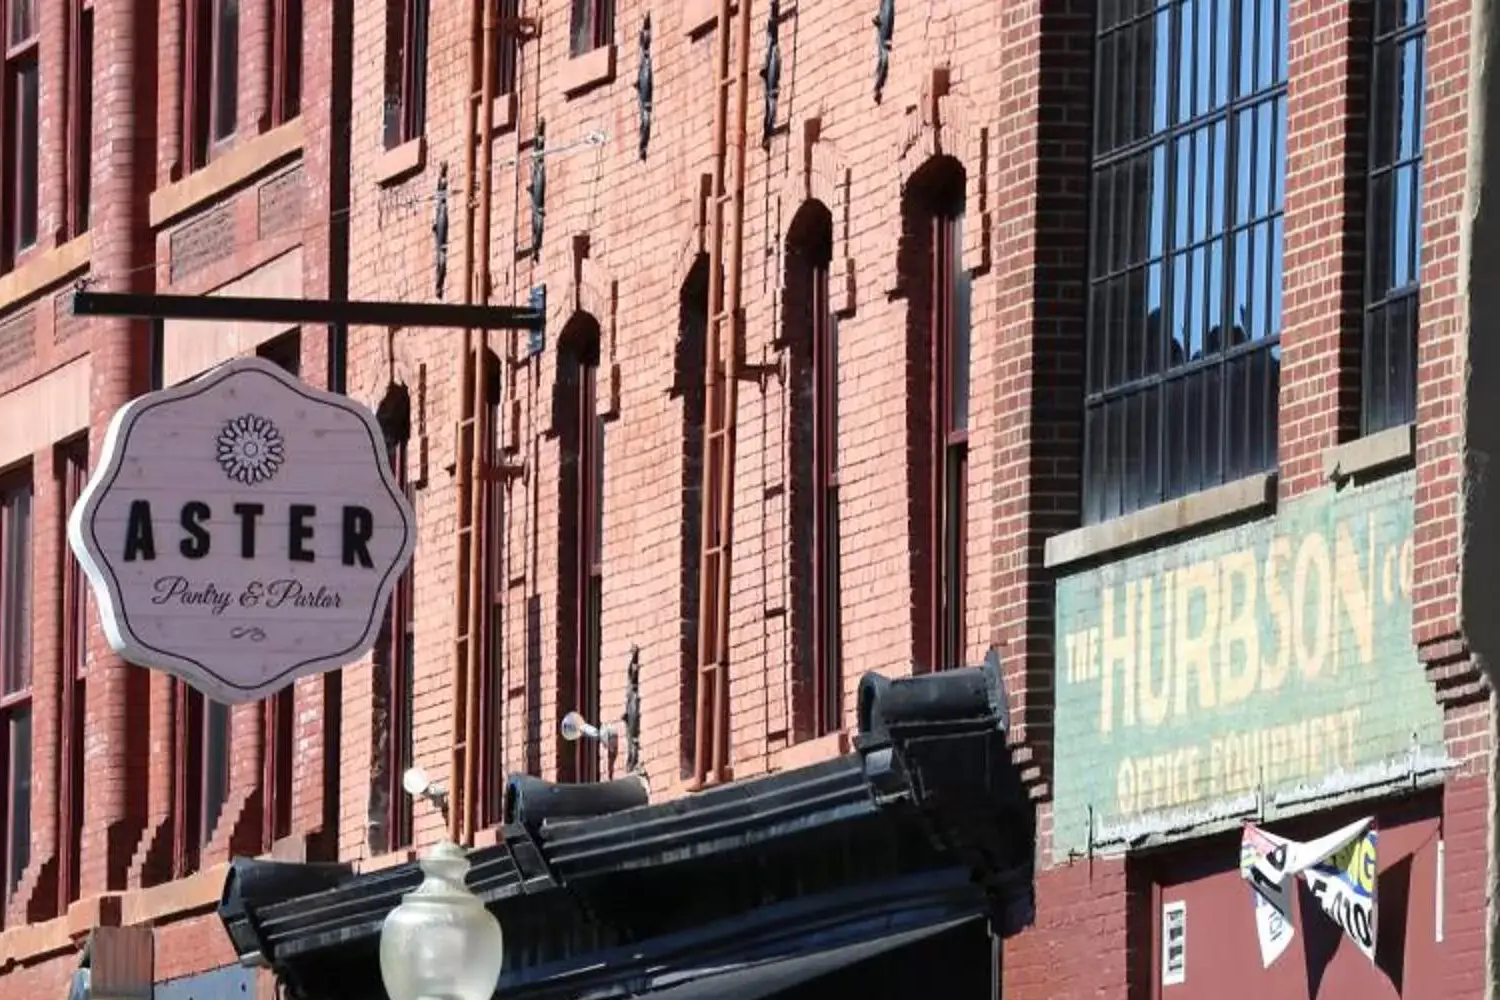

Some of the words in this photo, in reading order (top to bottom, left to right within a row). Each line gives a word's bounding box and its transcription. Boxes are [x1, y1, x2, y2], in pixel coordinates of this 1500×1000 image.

[123, 500, 375, 568] ASTER
[152, 576, 233, 615] Pantry
[239, 581, 266, 609] &
[1065, 628, 1100, 684] THE
[1099, 510, 1376, 738] HURBSON
